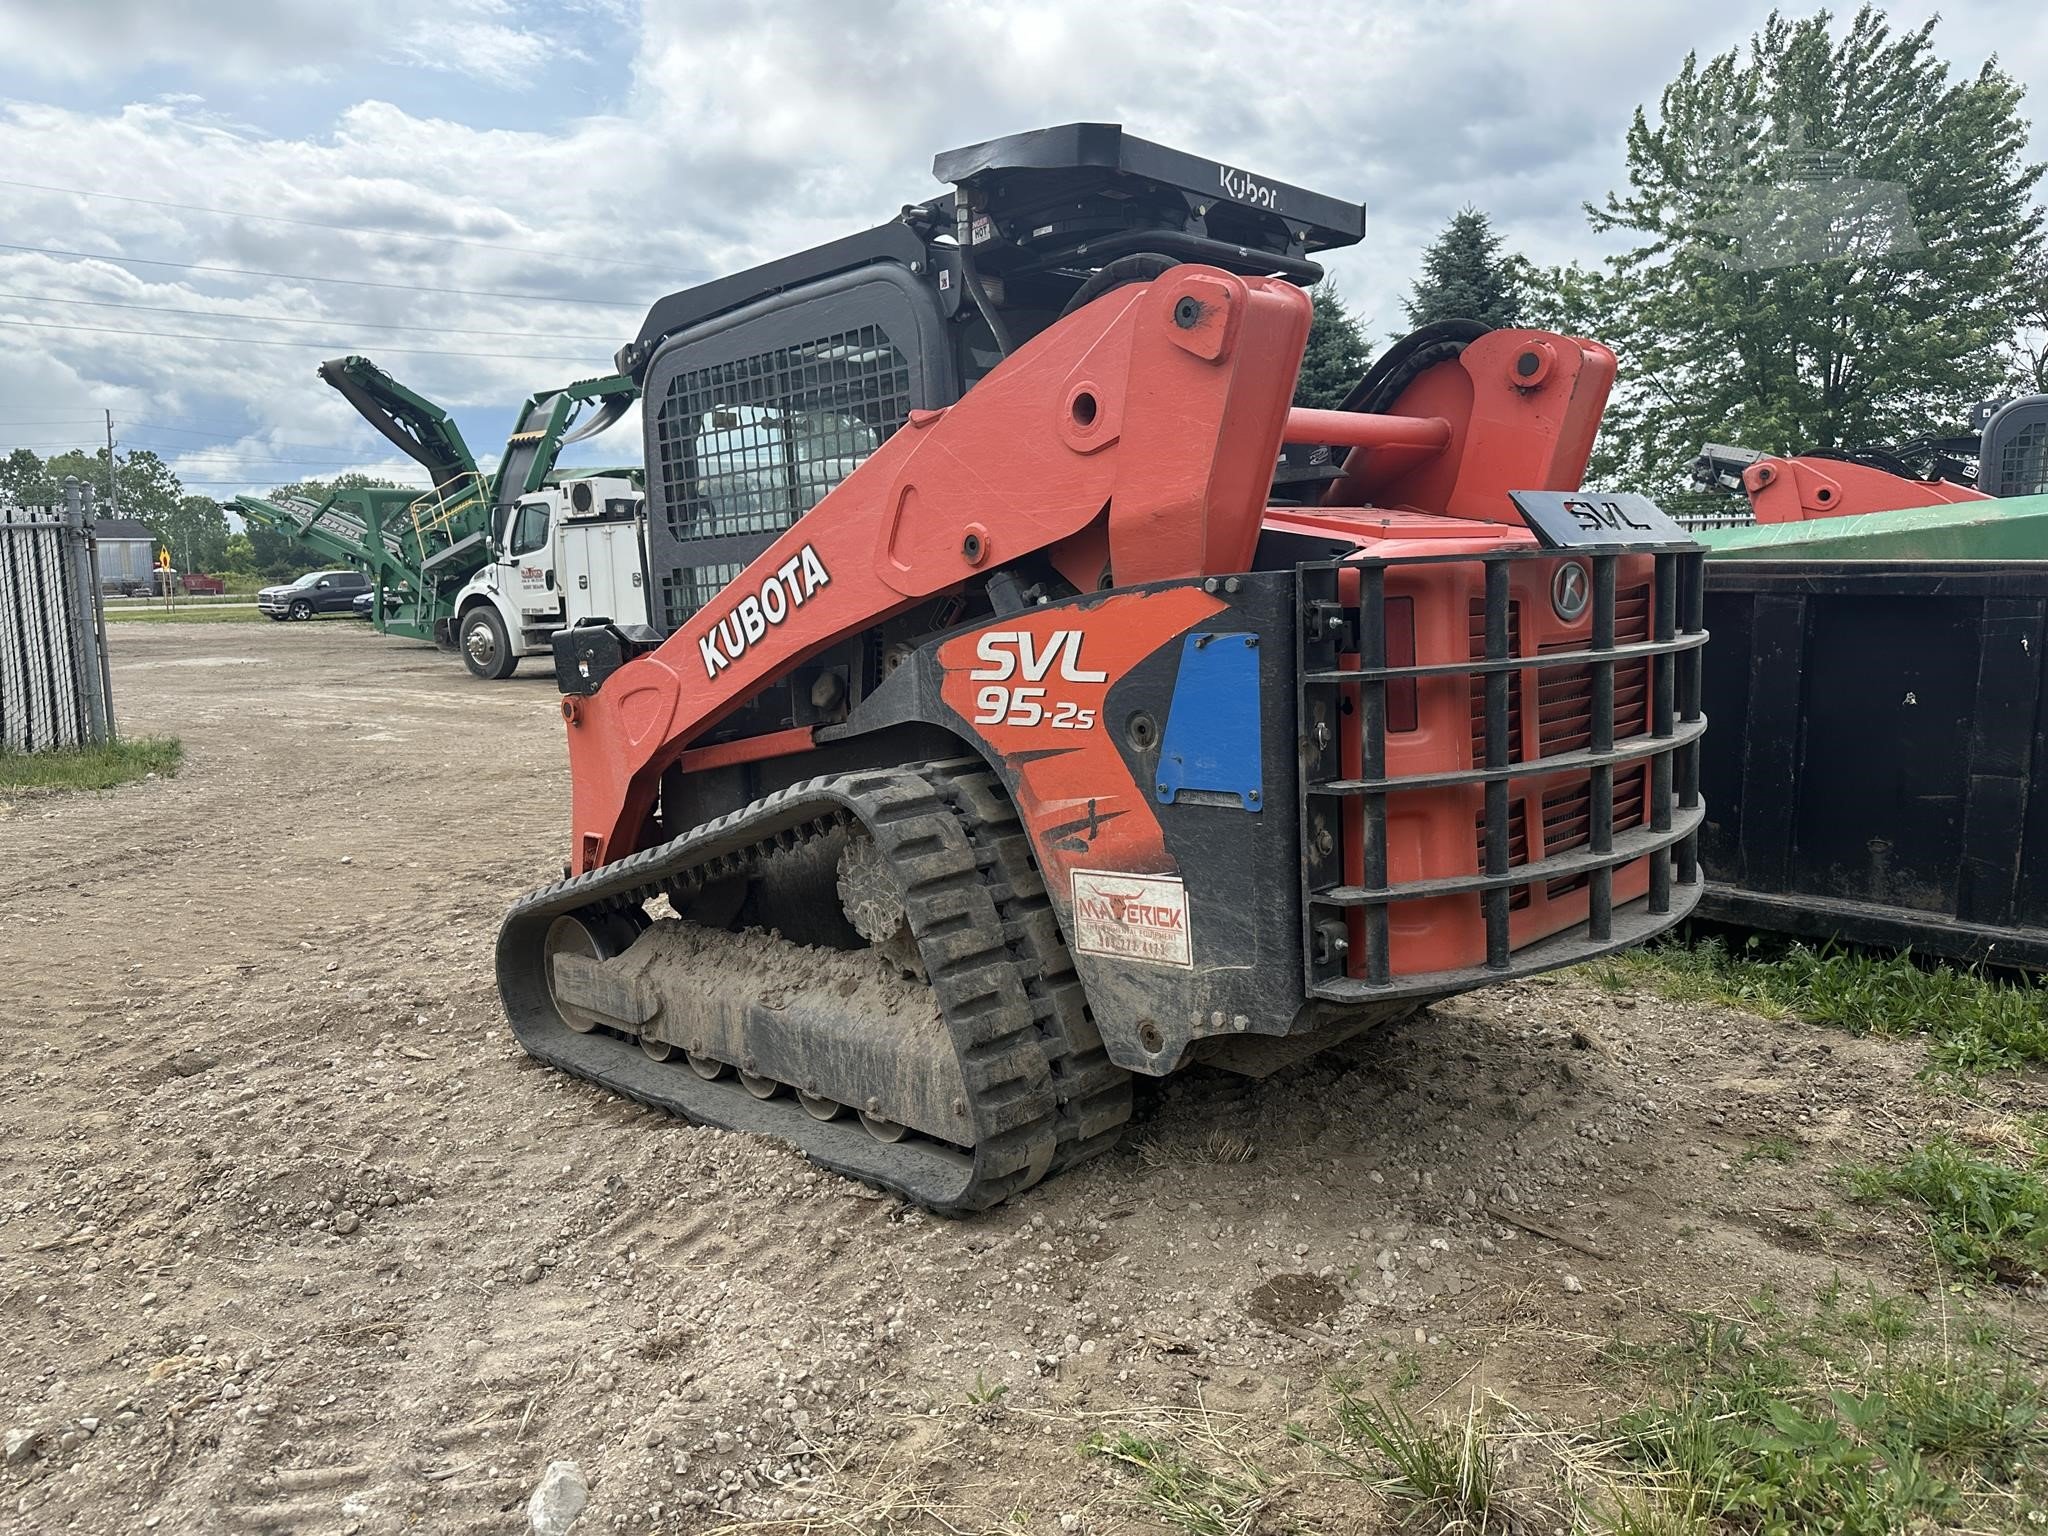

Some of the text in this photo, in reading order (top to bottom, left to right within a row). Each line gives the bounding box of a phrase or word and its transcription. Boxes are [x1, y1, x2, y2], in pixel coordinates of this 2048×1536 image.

[974, 226, 987, 239] HOT
[1563, 501, 1653, 531] SVL
[698, 544, 831, 679] KUBOTA
[969, 630, 1108, 683] SVL
